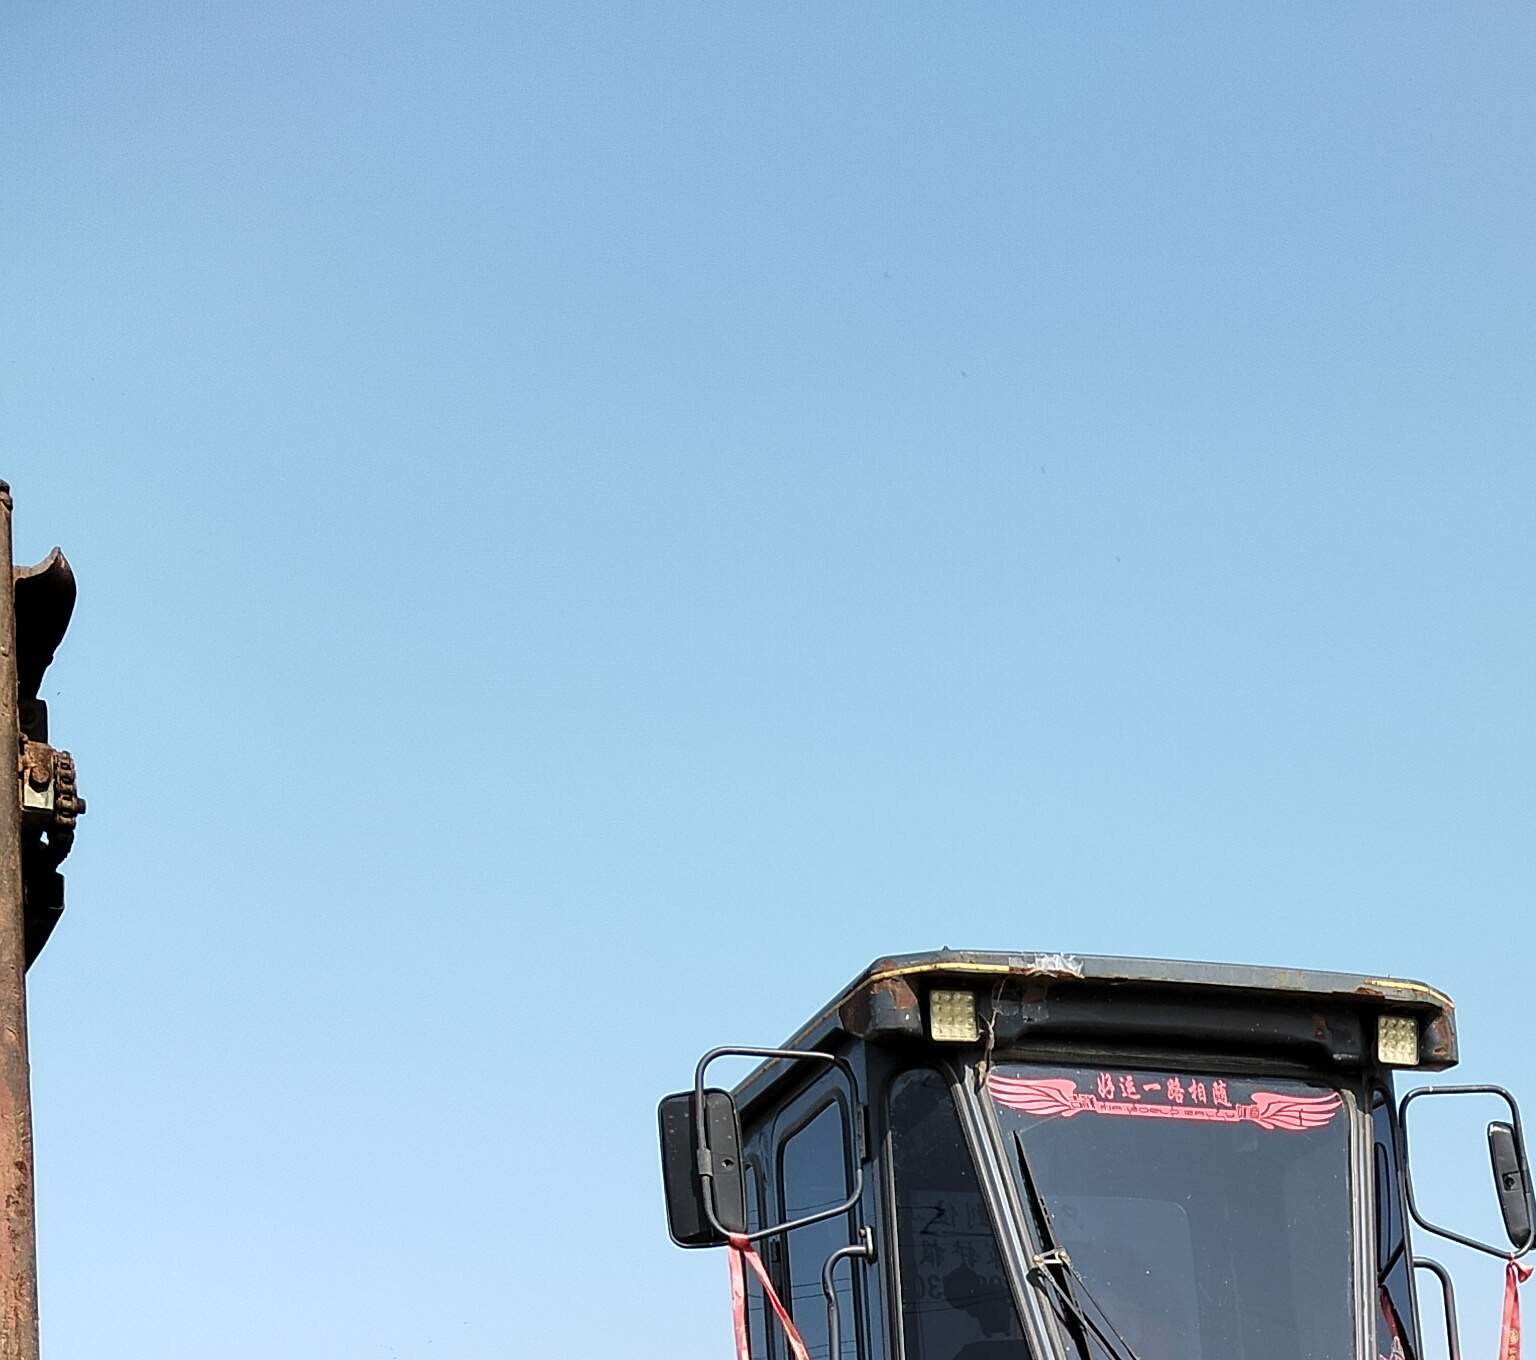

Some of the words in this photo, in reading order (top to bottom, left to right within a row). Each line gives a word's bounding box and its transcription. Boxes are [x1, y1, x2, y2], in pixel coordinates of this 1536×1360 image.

[1097, 1072, 1232, 1106] 好运一路相随
